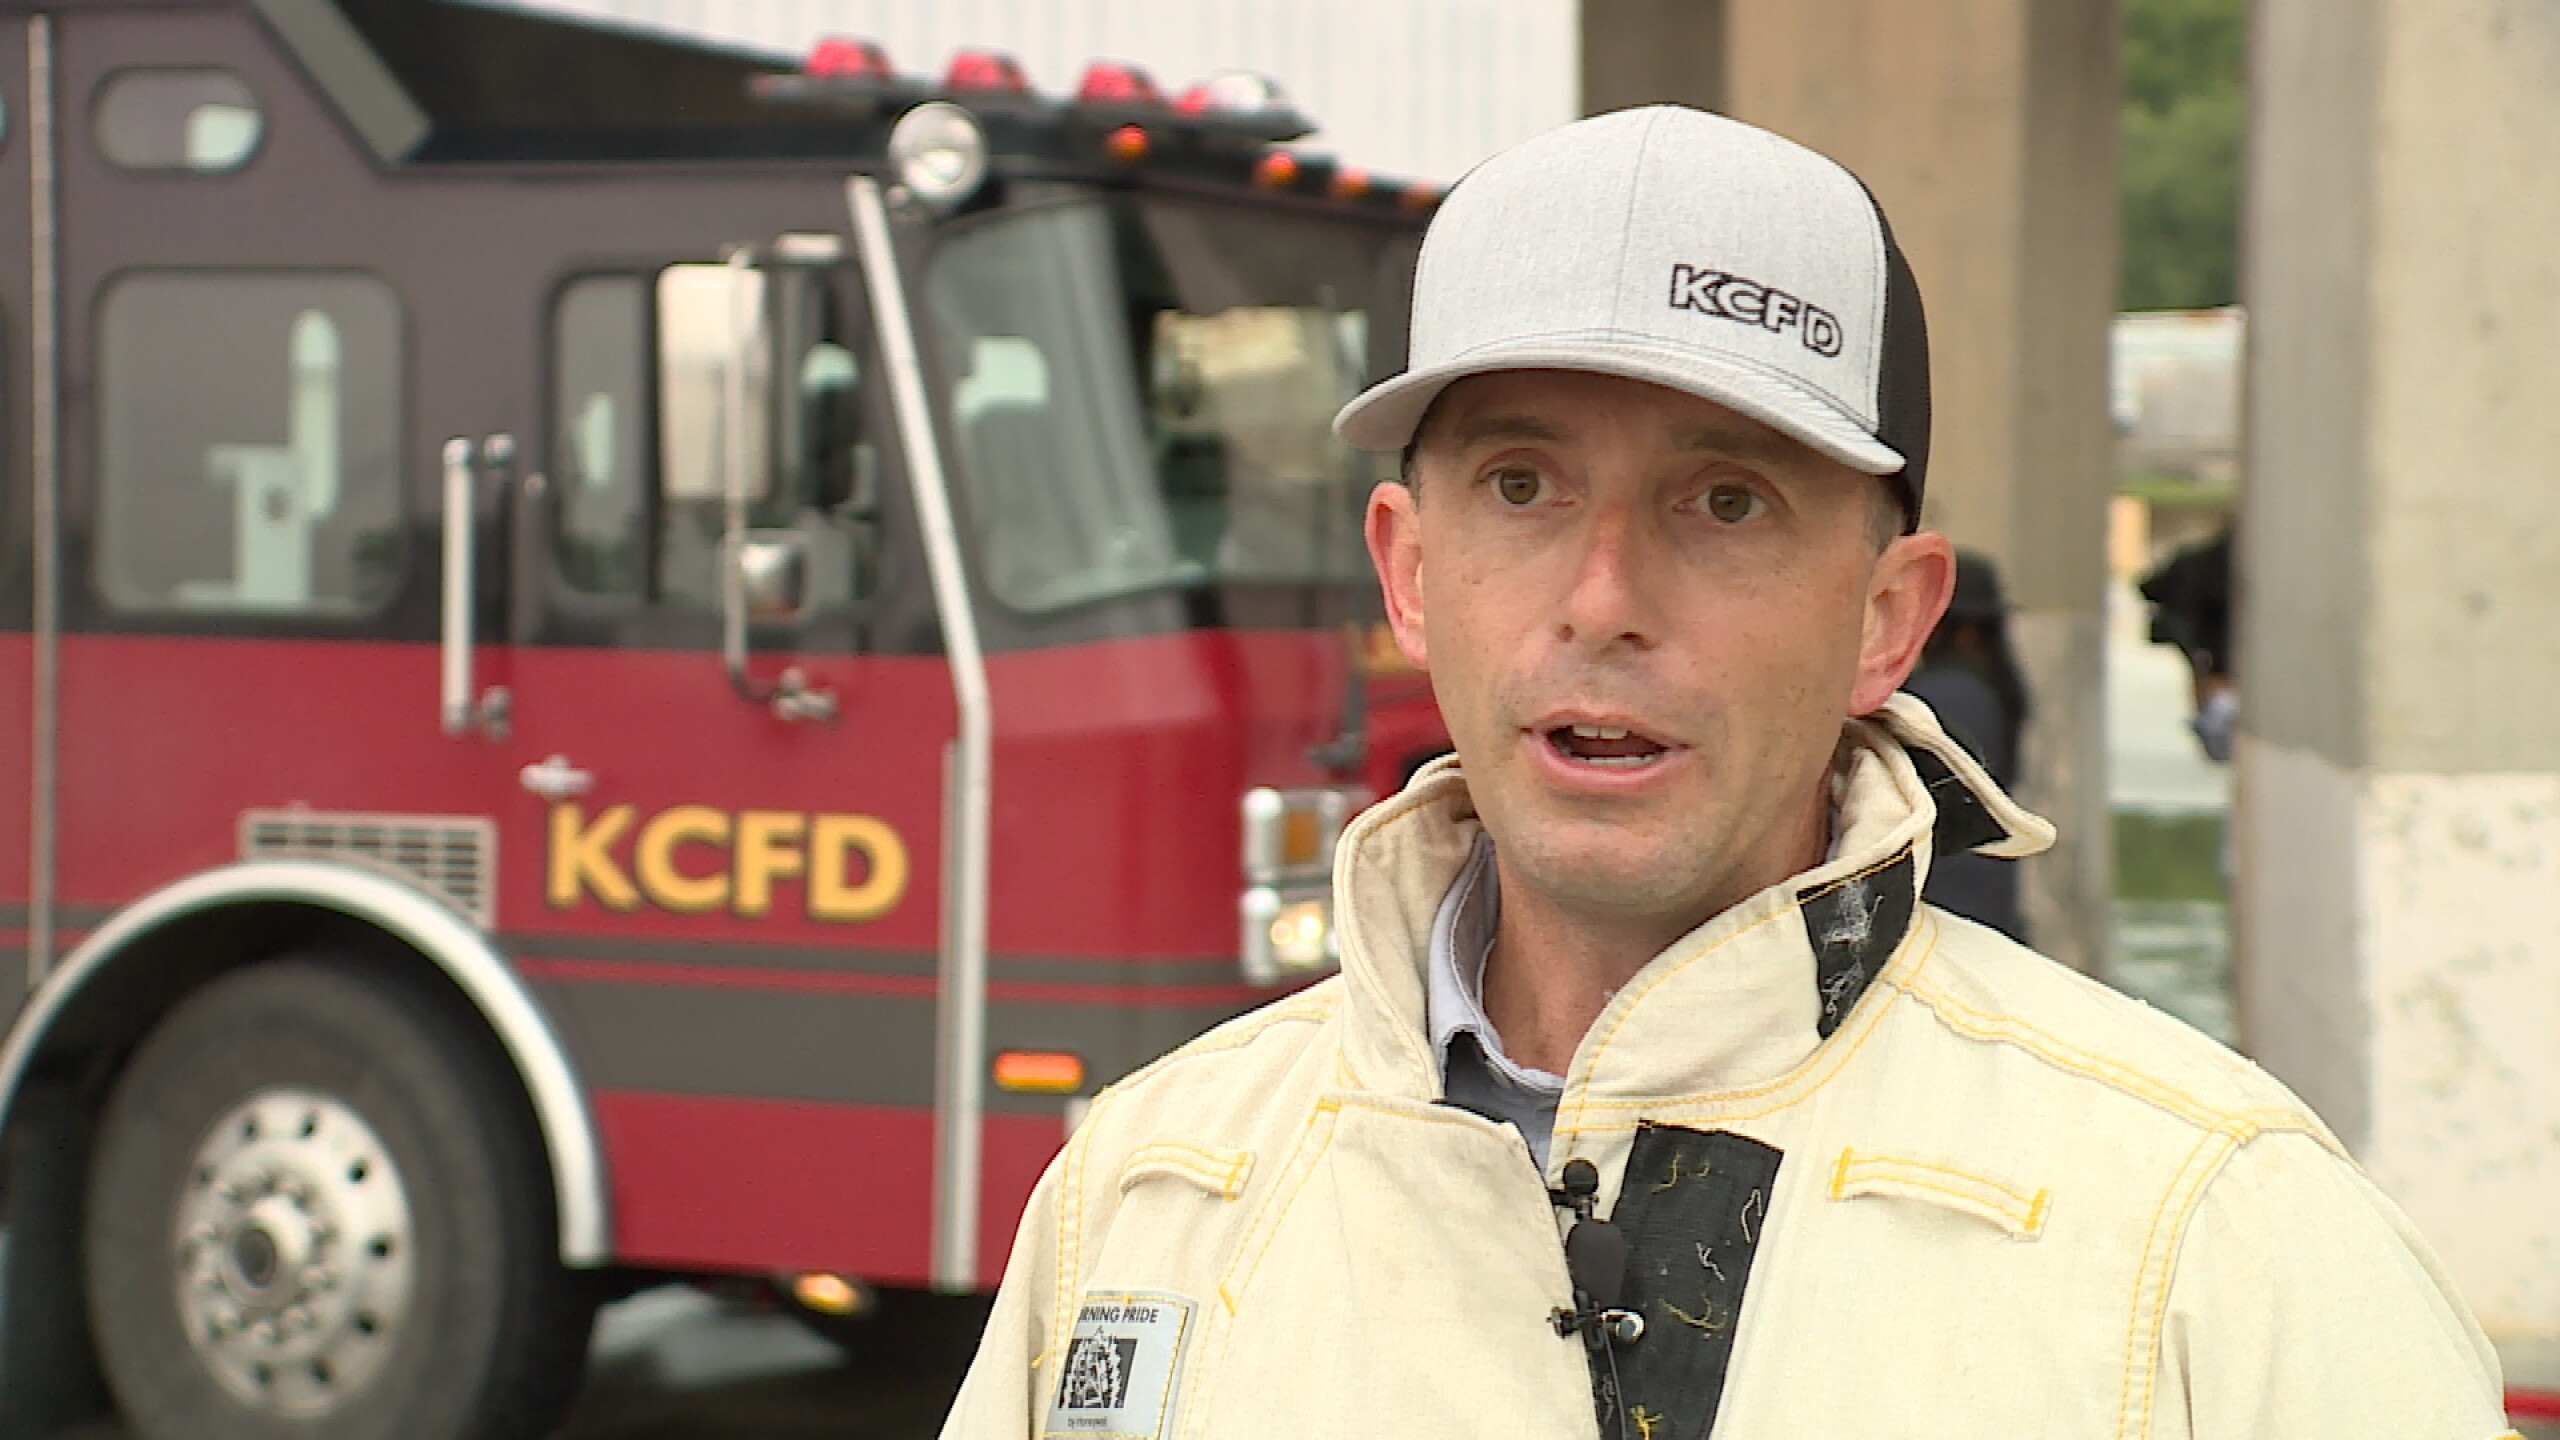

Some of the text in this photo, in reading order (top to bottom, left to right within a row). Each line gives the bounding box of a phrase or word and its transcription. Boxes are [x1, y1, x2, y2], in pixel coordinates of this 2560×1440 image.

[1669, 263, 1843, 357] KCFD
[545, 802, 910, 923] KCFD
[1122, 1306, 1159, 1323] PRIDE
